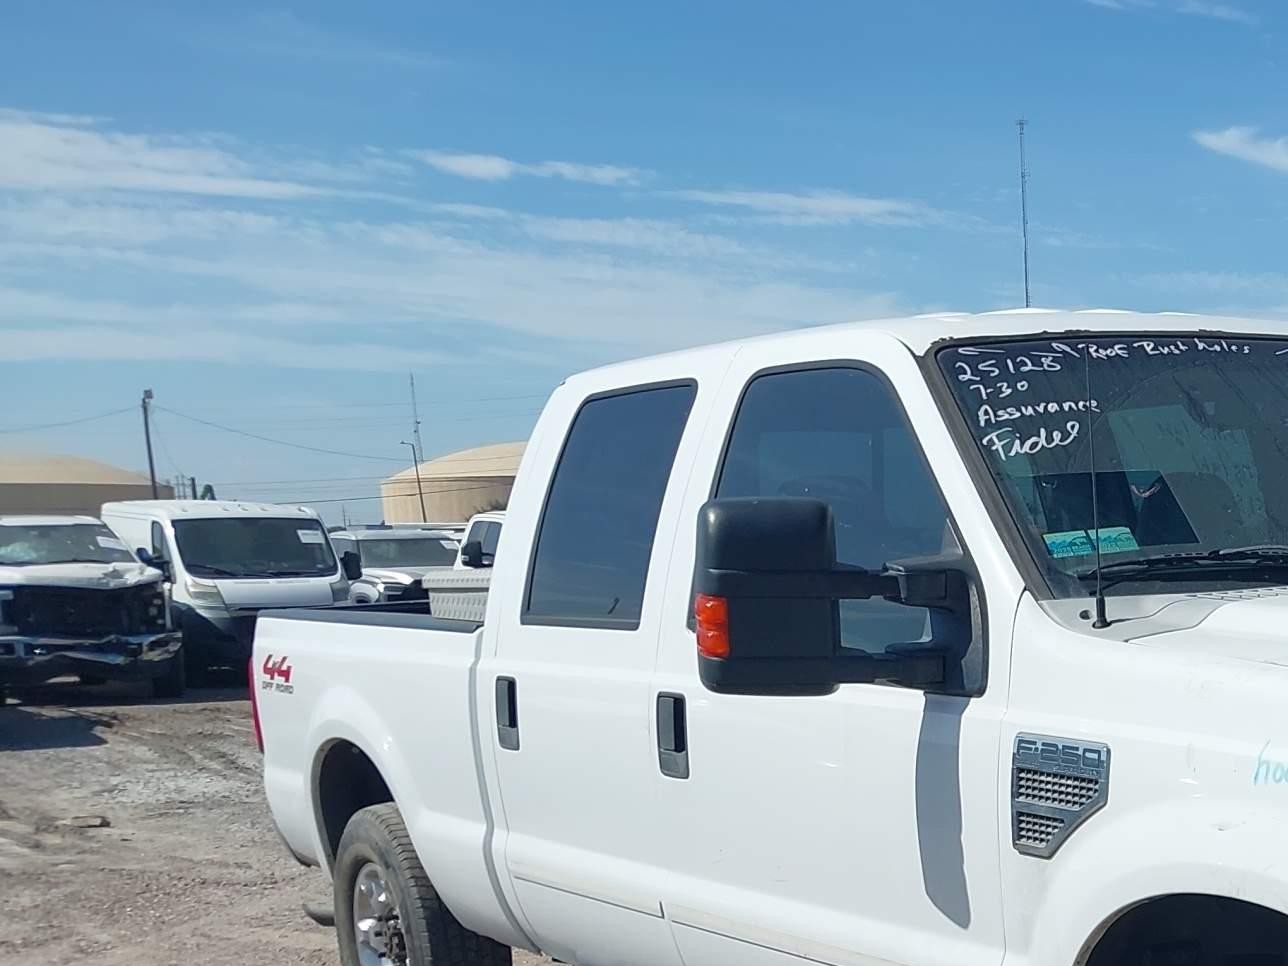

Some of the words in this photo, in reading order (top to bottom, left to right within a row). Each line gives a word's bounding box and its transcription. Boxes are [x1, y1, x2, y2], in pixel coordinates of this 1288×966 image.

[954, 355, 1062, 382] 25128
[977, 399, 1101, 428] Assurance
[981, 420, 1080, 461] Fidel
